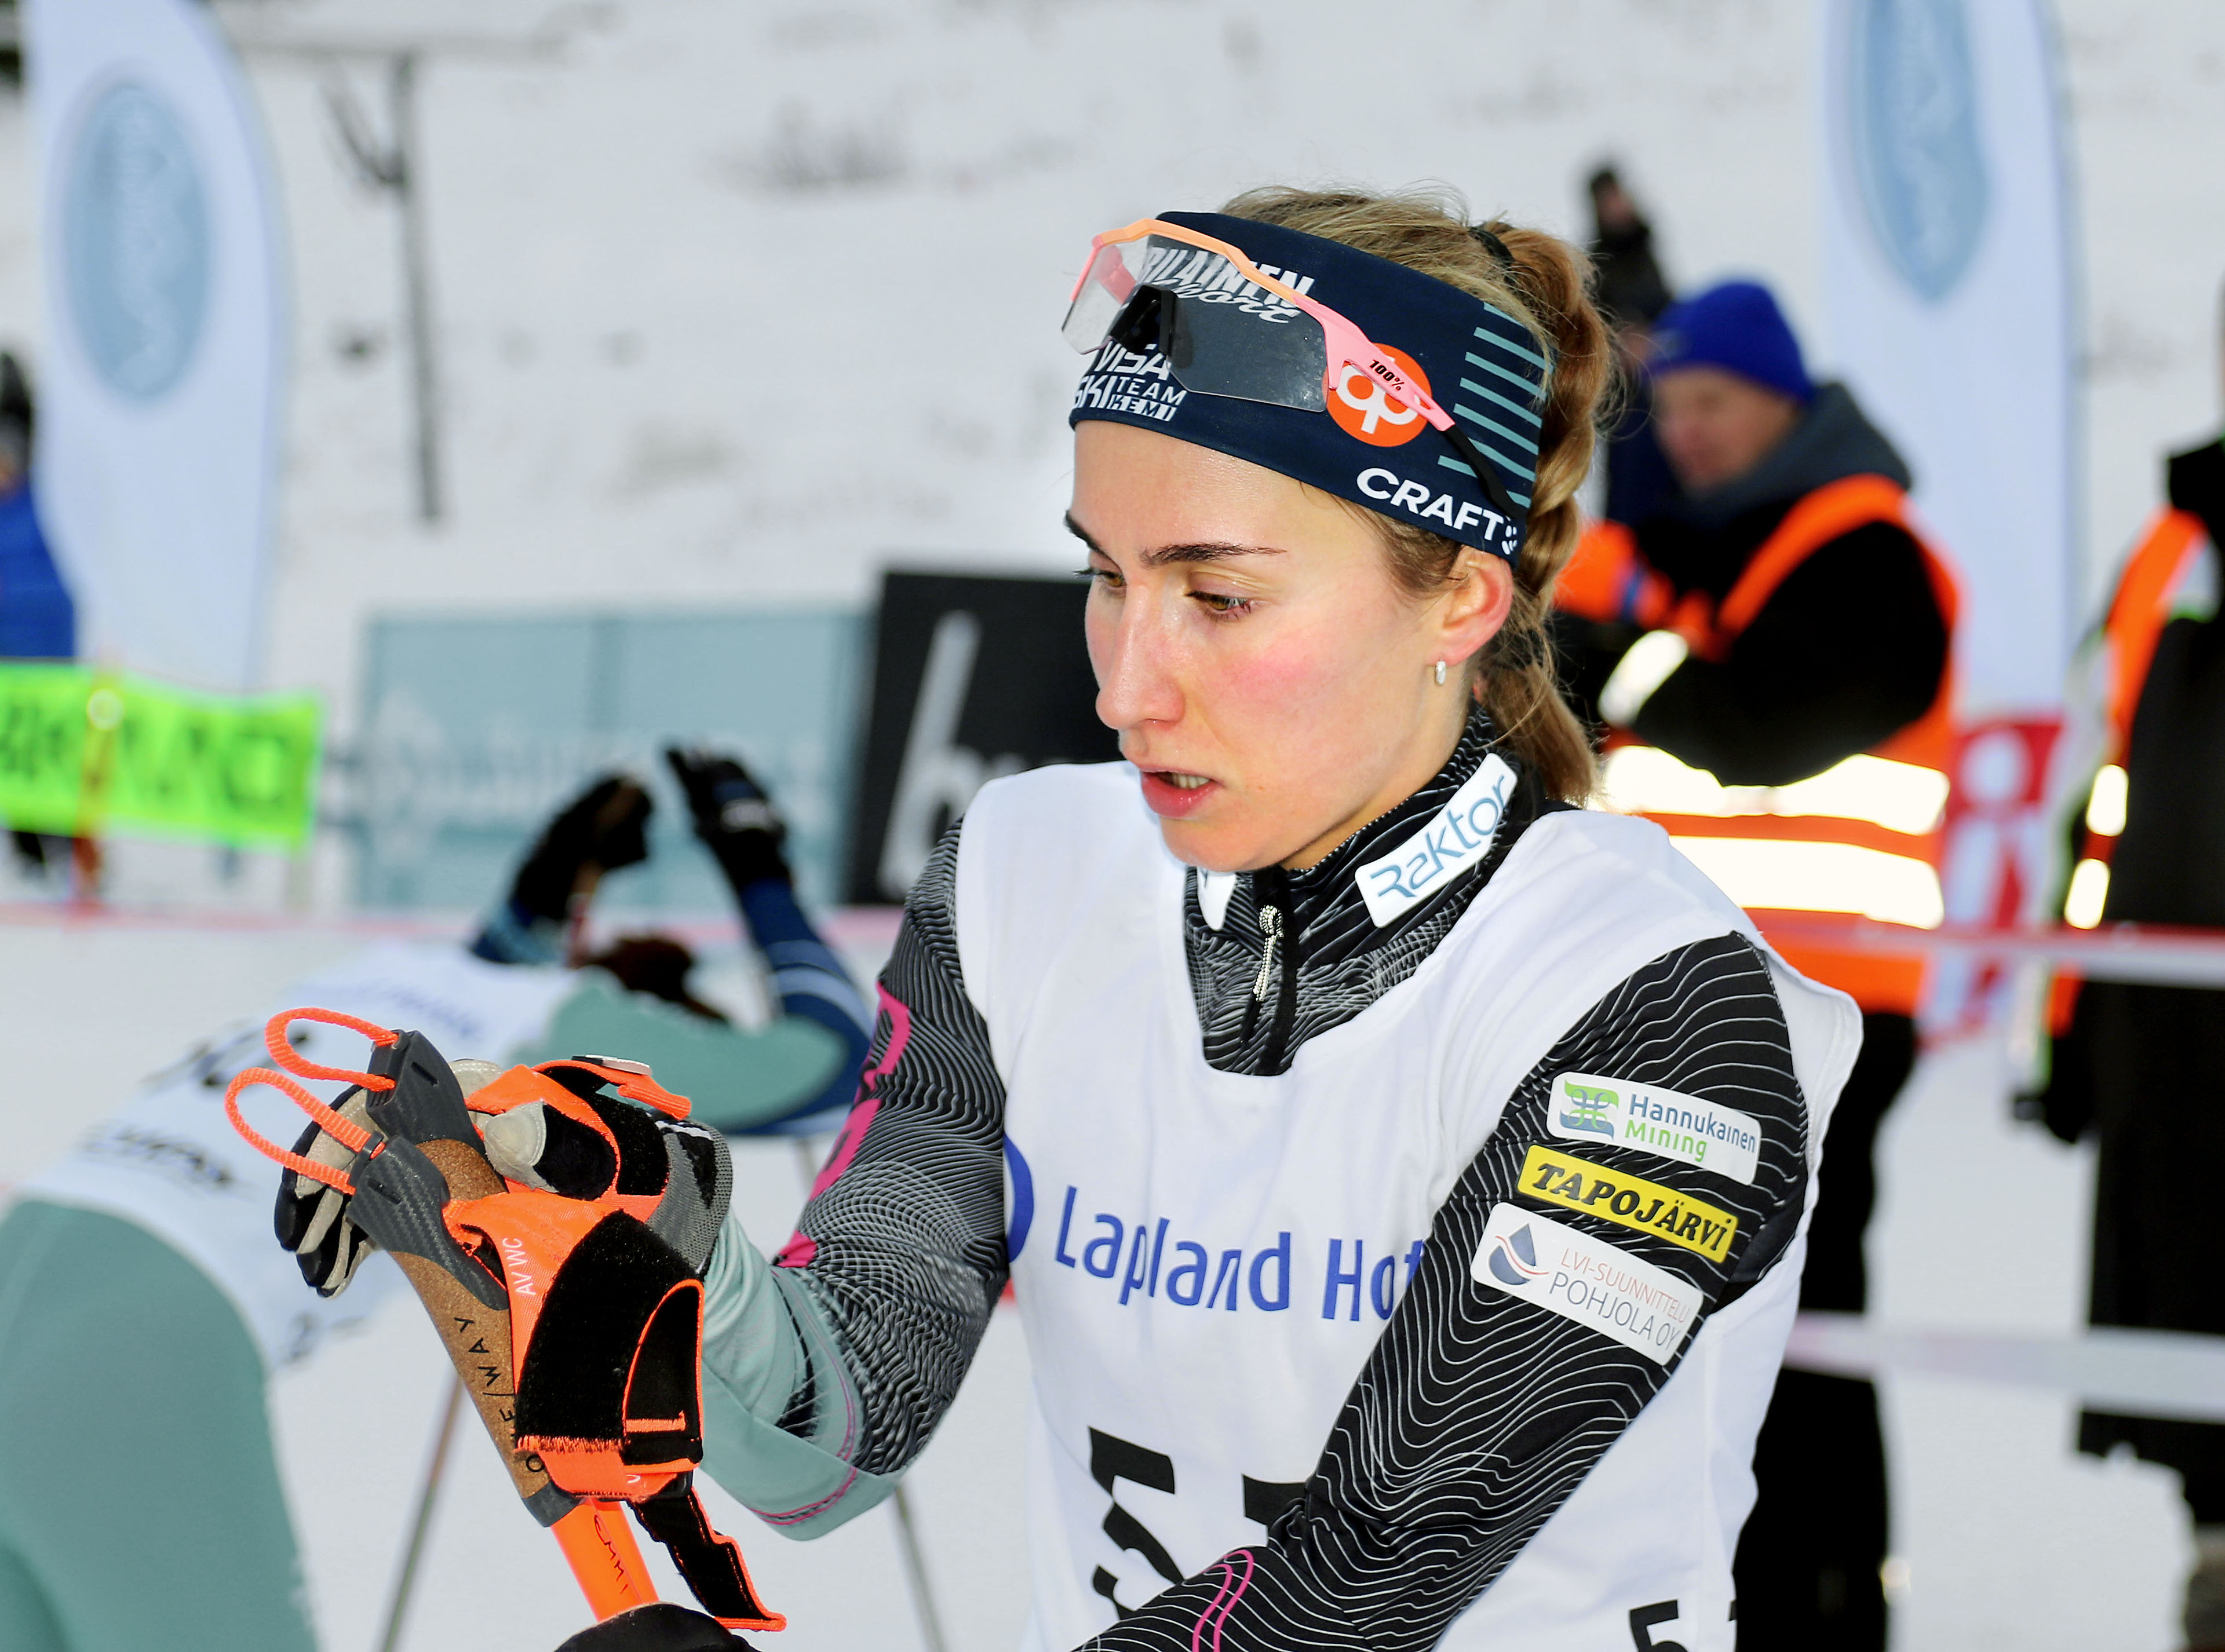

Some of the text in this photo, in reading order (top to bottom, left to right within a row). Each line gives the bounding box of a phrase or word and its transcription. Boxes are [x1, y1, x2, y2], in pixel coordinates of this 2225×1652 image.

[1072, 375, 1188, 409] SKI TEAM
[1369, 359, 1405, 391] 100%
[1107, 394, 1177, 421] KEMI
[1356, 468, 1505, 541] CRAFT
[1369, 775, 1508, 899] Raktor
[1624, 1122, 1708, 1163] Mining
[1629, 1093, 1756, 1154] Hannukainen
[502, 1237, 537, 1296] AV WC
[1055, 1185, 1292, 1312] Lapland
[1548, 1271, 1681, 1351] POHJOLA OY
[1560, 1248, 1691, 1323] LVI-SUUNNITTELU
